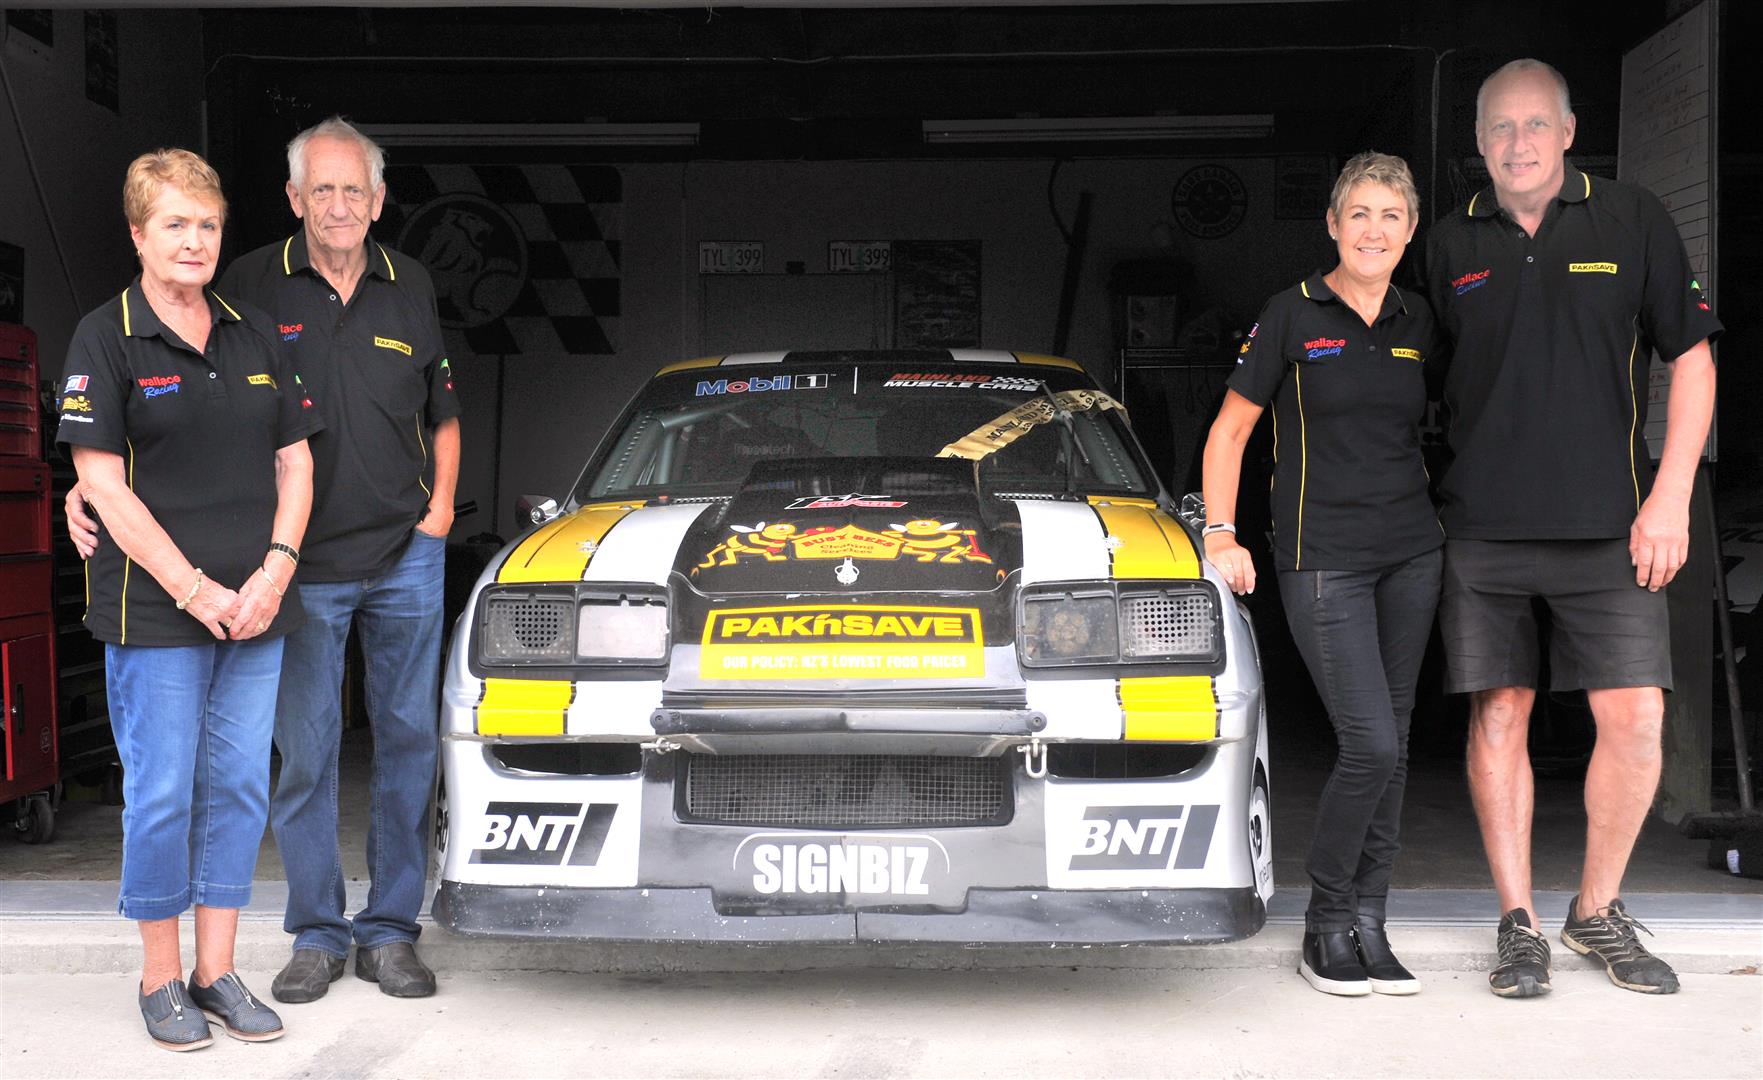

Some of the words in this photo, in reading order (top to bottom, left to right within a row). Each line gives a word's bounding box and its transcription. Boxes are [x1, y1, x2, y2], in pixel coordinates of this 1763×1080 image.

[703, 249, 727, 266] TYL
[736, 249, 761, 266] 399
[831, 248, 857, 266] TYL
[864, 248, 890, 266] 399
[1452, 268, 1491, 288] wallace
[1304, 337, 1346, 350] wallace
[1307, 347, 1343, 361] Racing
[137, 374, 182, 387] wallace
[695, 375, 792, 397] Mobil
[883, 380, 975, 389] MUSCLE
[978, 382, 1041, 392] CARS
[889, 372, 992, 383] MAINLAND
[143, 382, 180, 399] Racing
[801, 533, 848, 547] BUSY
[852, 534, 895, 547] BEES
[722, 655, 748, 669] OUR
[750, 655, 798, 669] POLICY:
[801, 655, 828, 669] NZ'S
[832, 655, 882, 669] LOWEST
[887, 655, 919, 669] FOOD
[923, 655, 966, 669] PRICES
[475, 814, 579, 851] BNT
[1074, 818, 1181, 855] BNT
[753, 843, 929, 895] SIGNBIZ
